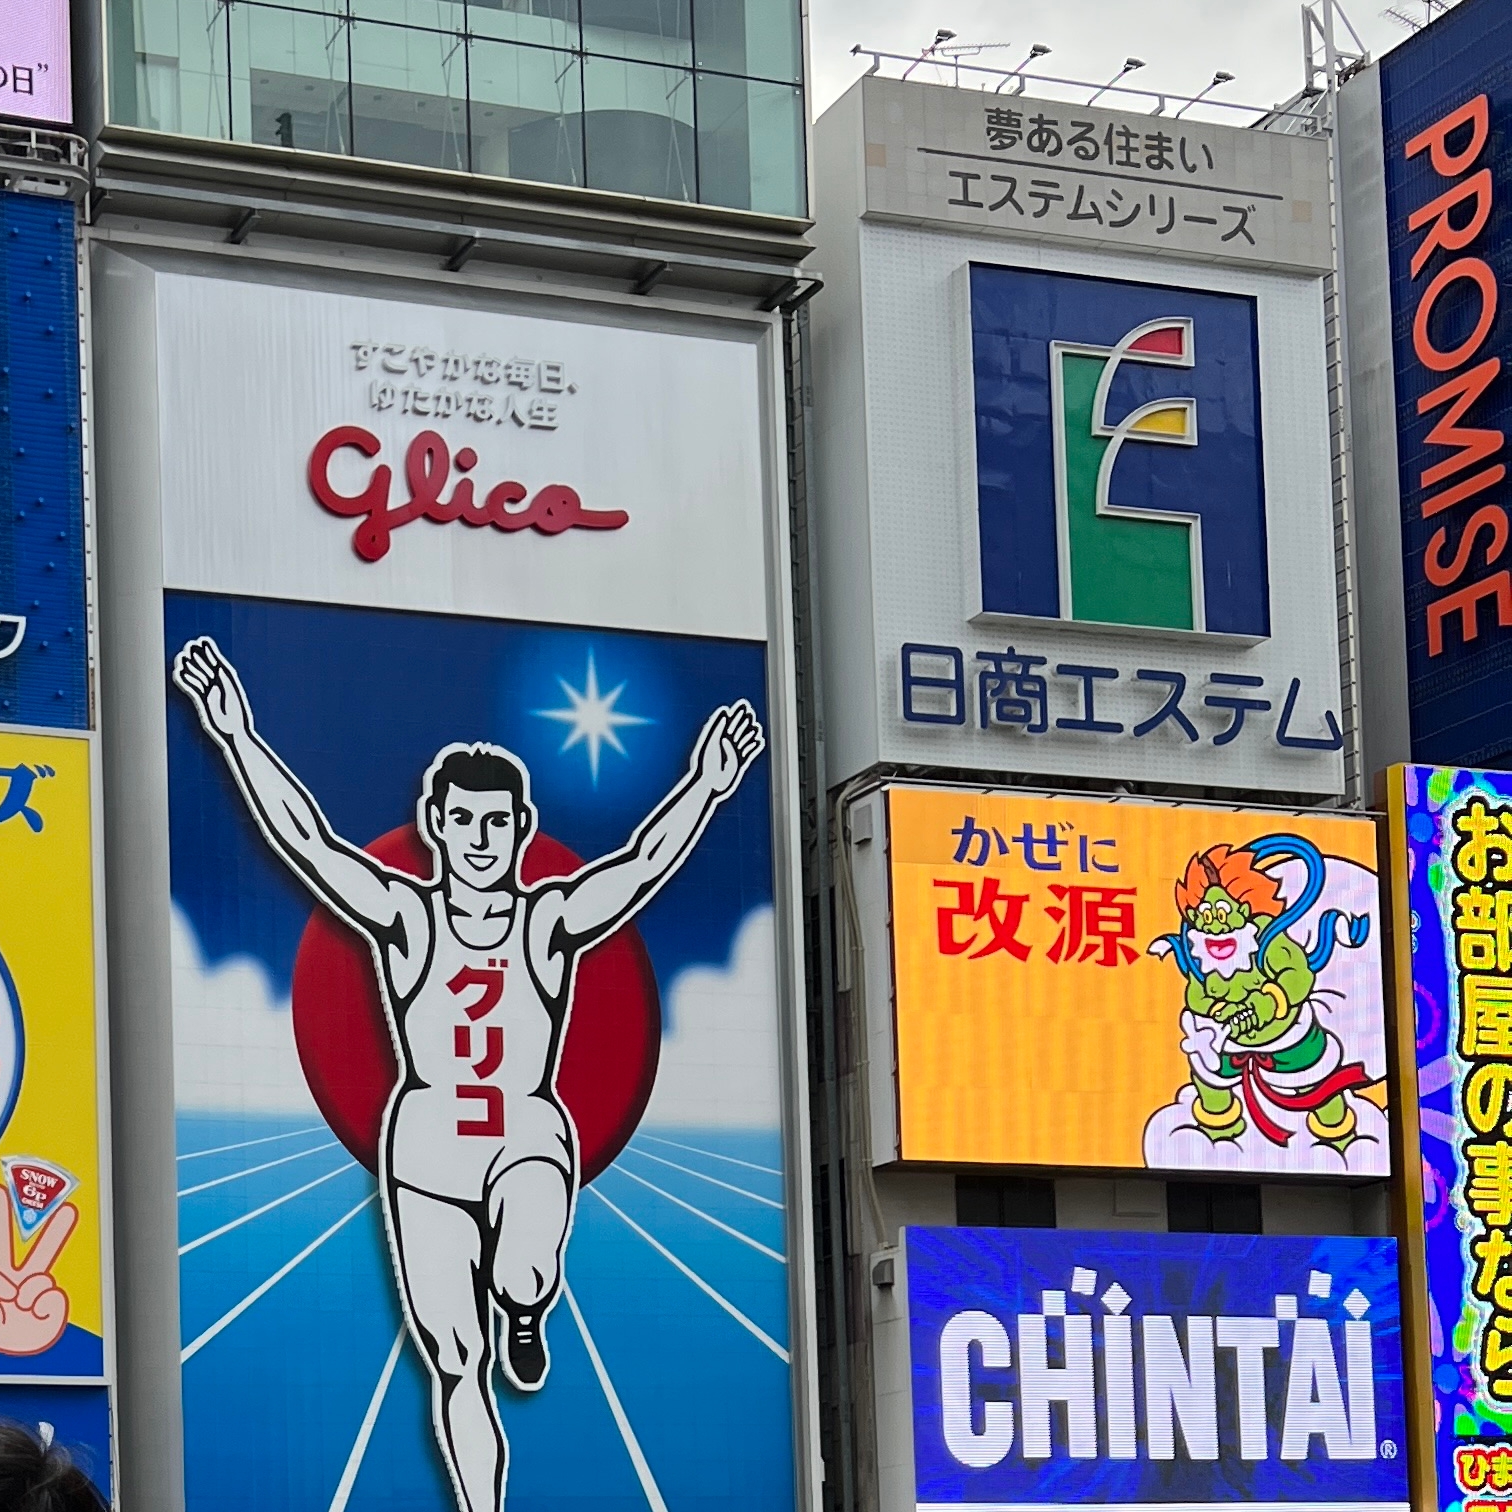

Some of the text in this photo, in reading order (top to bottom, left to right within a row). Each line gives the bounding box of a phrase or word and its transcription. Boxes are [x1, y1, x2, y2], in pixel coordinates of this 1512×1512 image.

[984, 107, 1214, 175] 夢ある住まい
[947, 170, 1257, 246] エステムシリーズ
[369, 380, 559, 430] ゆたかな人生
[1403, 92, 1512, 658] PROMISE
[308, 426, 629, 561] Glico
[900, 642, 1343, 751] 日商エステム
[951, 816, 1120, 874] かぜに
[931, 876, 1142, 968] 改源
[445, 957, 509, 1138] グリコ
[19, 1168, 59, 1188] SNOW
